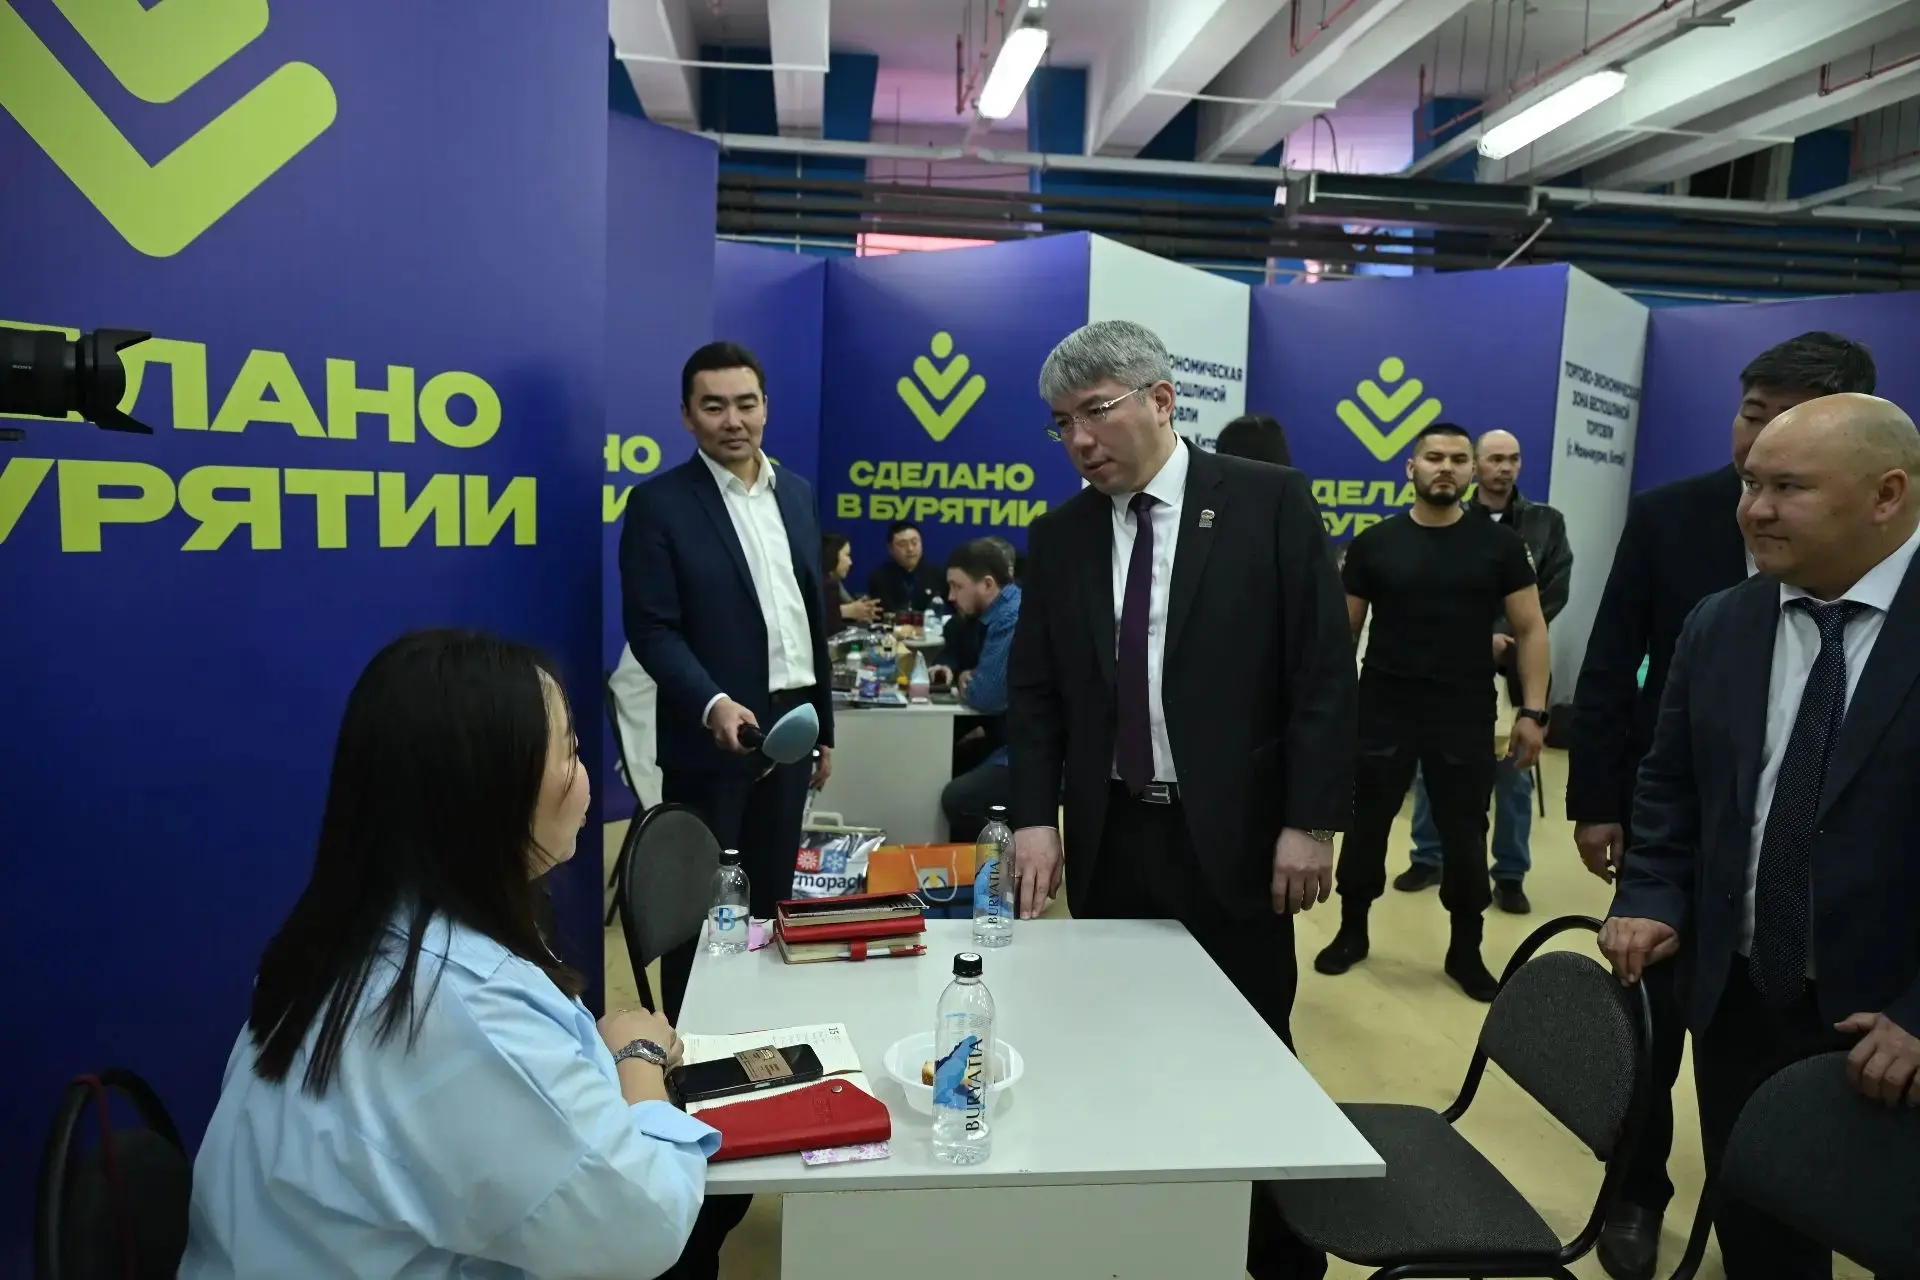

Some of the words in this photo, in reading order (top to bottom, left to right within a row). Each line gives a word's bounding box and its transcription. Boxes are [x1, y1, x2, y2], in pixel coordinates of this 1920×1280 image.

[0, 319, 501, 448] ЛАНО
[849, 460, 1035, 491] СДЕЛАНО
[837, 493, 862, 518] В
[869, 494, 1047, 527] БУРЯТИИ
[988, 861, 1001, 924] BURYATIA
[965, 1038, 983, 1132] BURYATIA
